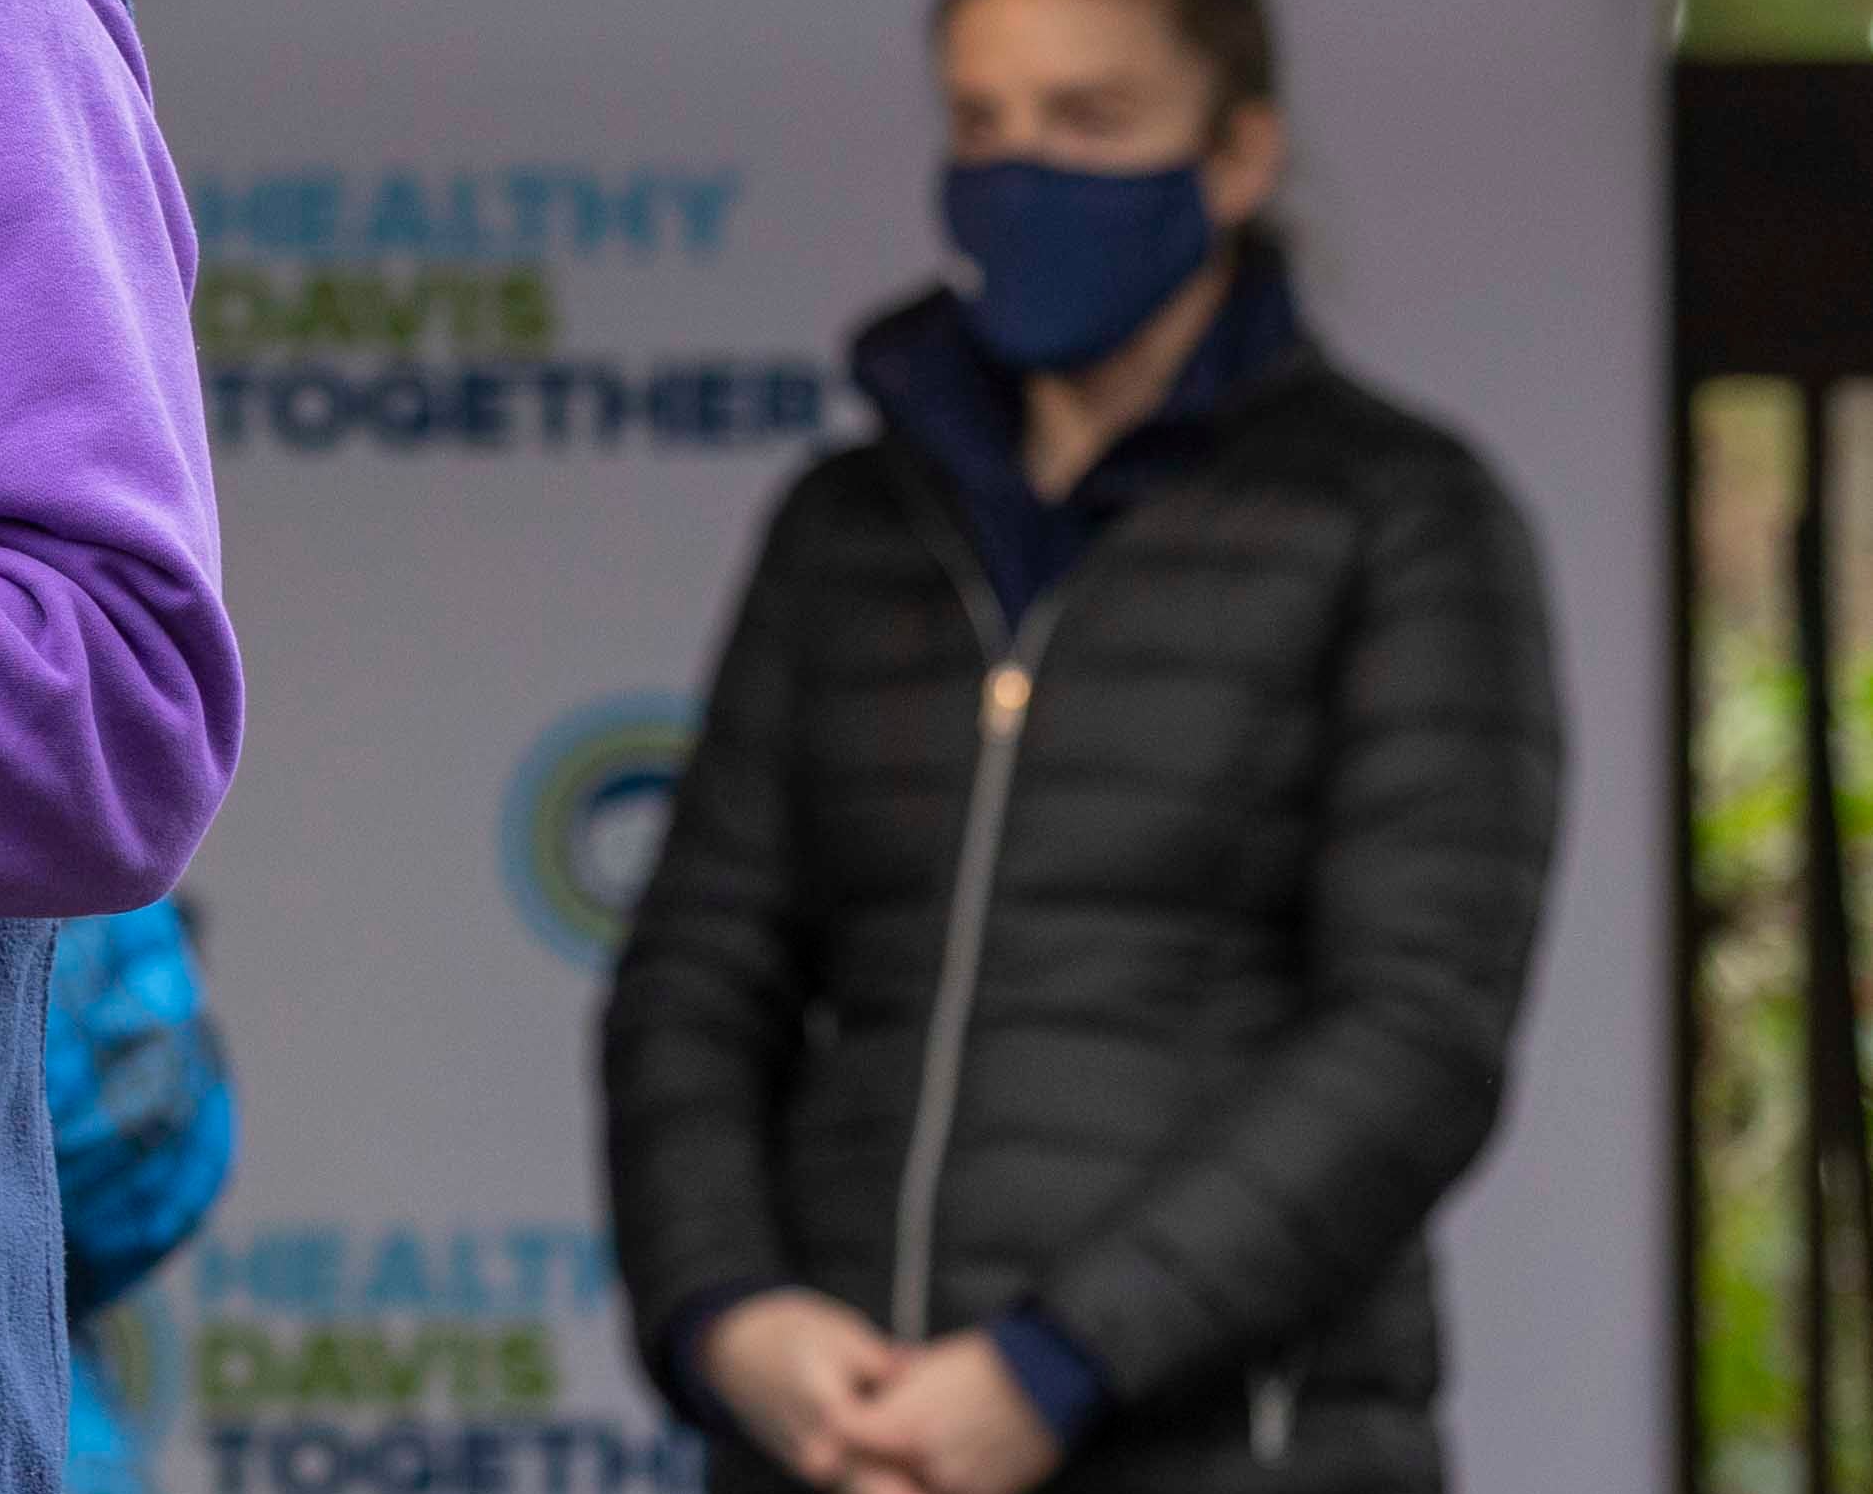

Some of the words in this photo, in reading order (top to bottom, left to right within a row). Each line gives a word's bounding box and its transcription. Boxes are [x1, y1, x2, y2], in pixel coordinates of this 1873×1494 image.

[197, 169, 738, 251] HEALTHY
[195, 267, 552, 353] DAVIS
[210, 363, 826, 443] TOGETHER
[197, 1225, 616, 1309] HEALT
[199, 1321, 562, 1411] DAVIS
